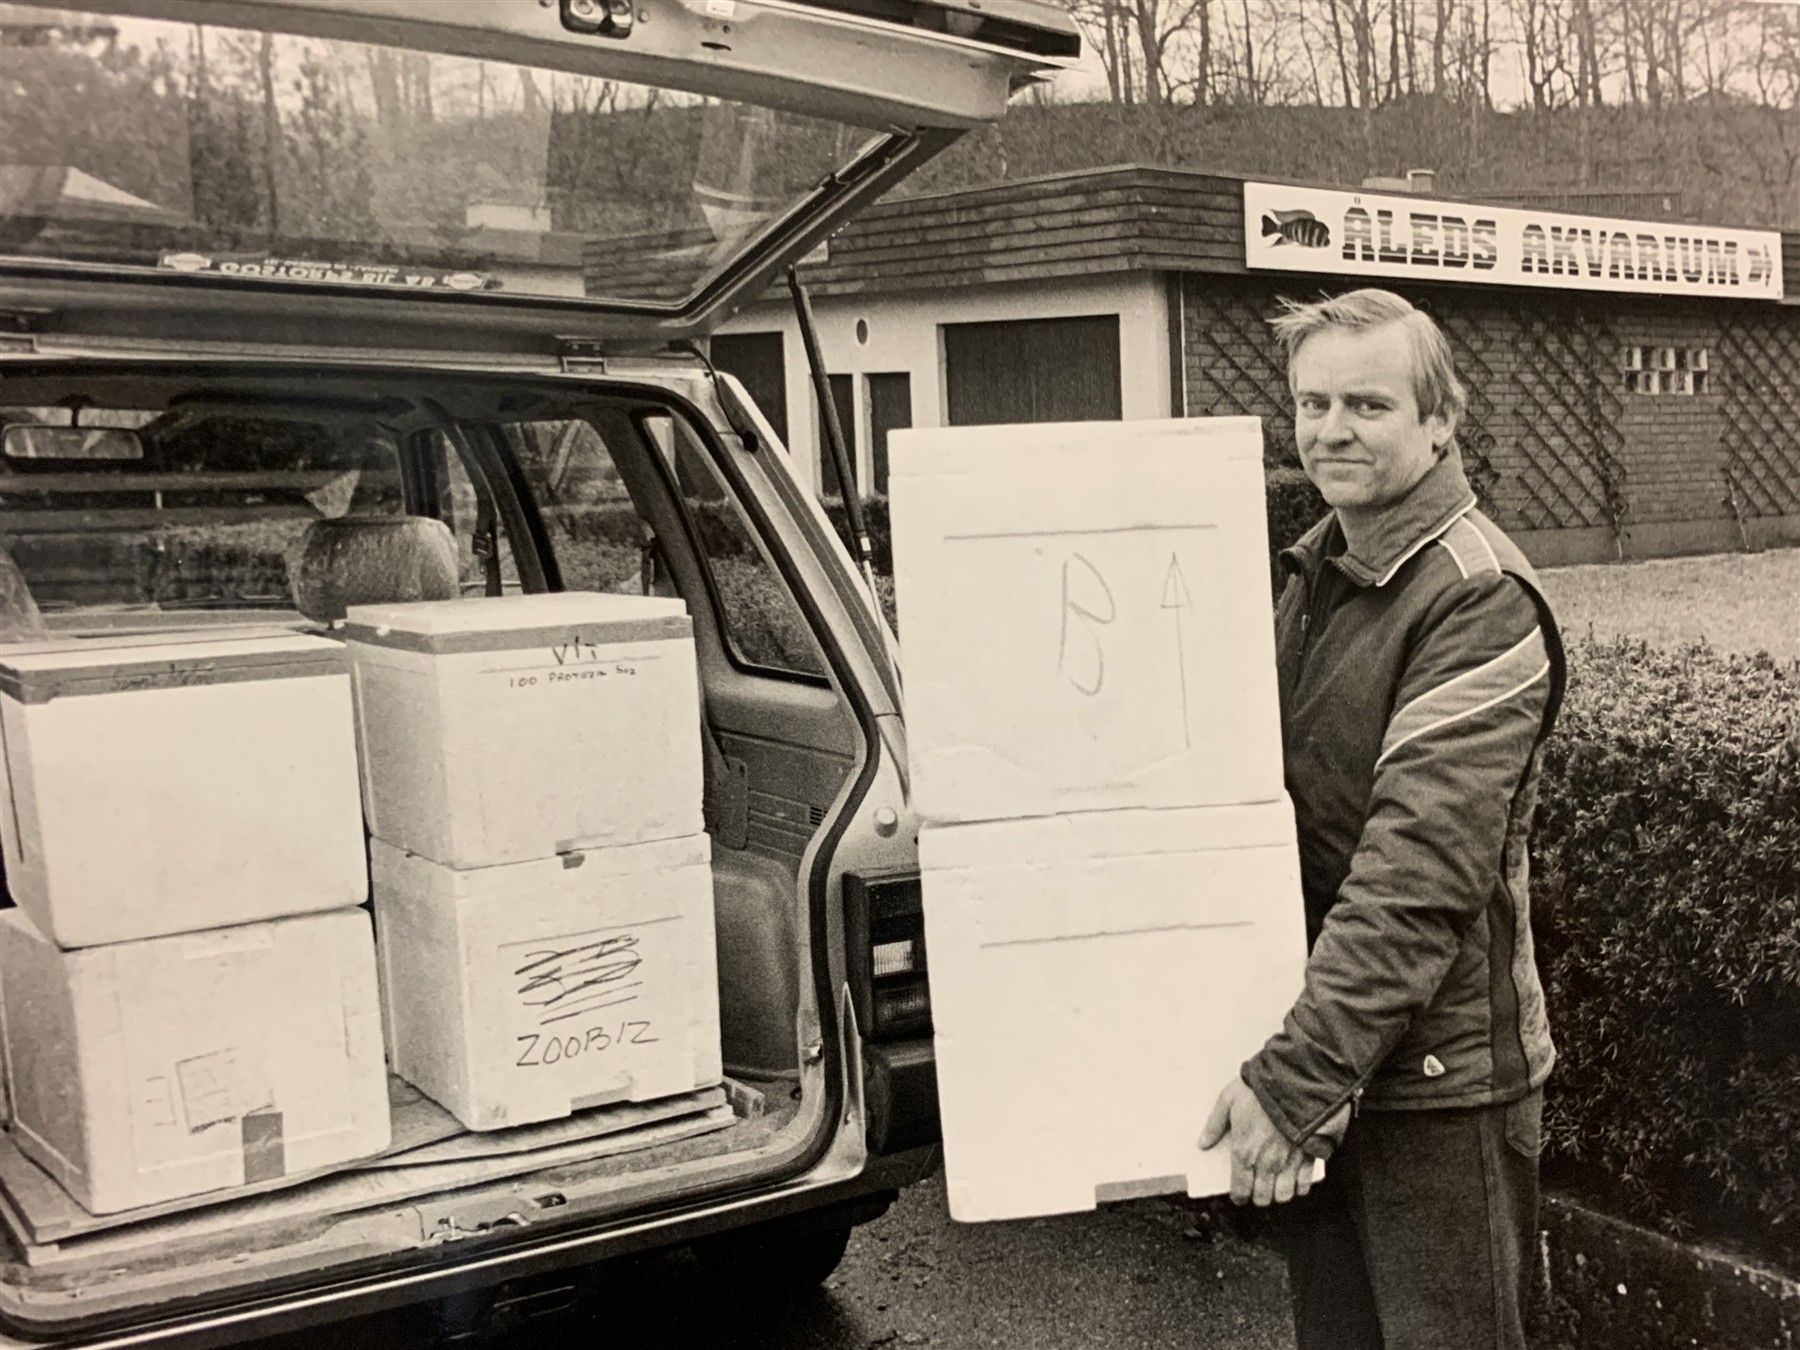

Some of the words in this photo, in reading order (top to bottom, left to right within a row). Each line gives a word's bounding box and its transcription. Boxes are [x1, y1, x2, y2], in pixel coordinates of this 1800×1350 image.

[1521, 223, 1740, 286] AKVARIUM
[1057, 551, 1117, 698] B
[509, 675, 539, 689] 100
